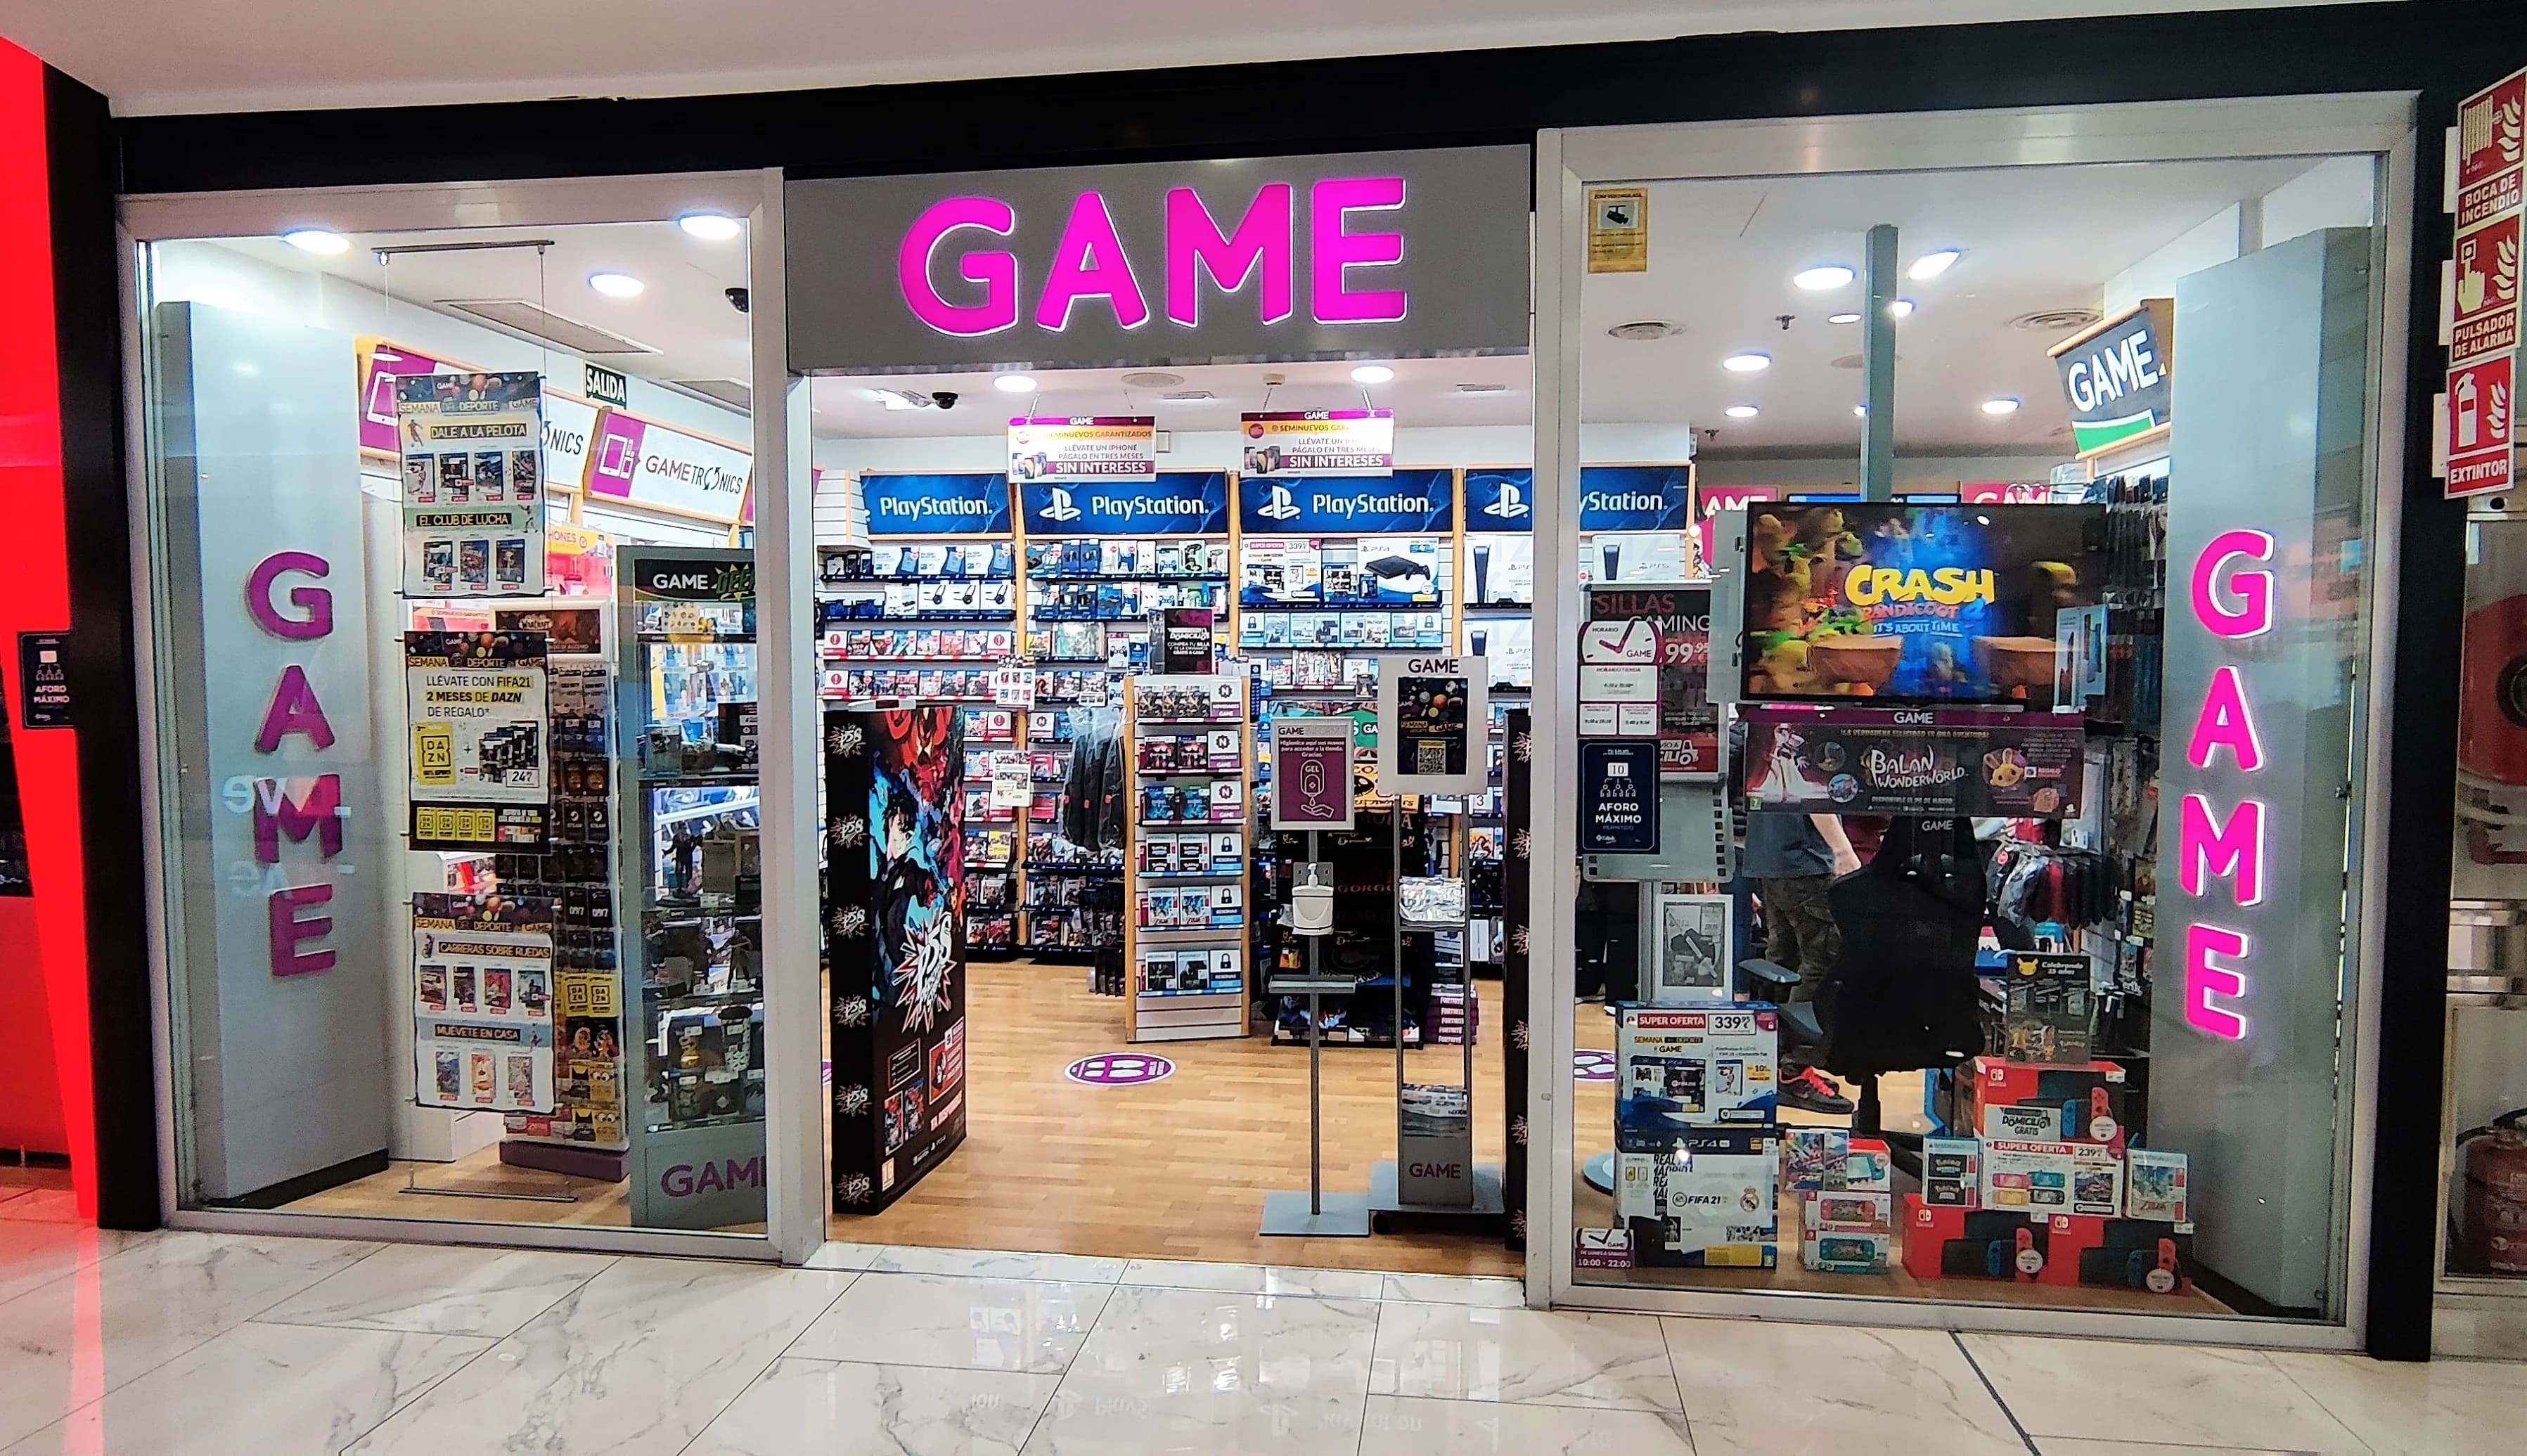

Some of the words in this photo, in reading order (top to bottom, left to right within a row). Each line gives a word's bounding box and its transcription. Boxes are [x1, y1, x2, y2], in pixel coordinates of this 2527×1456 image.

[2464, 182, 2497, 208] BOCA
[2500, 173, 2516, 193] DE
[2461, 188, 2519, 225] INCENDIO
[899, 176, 1407, 337] GAME
[2455, 311, 2514, 343] PULSADOR
[2454, 344, 2467, 359] DE
[2469, 330, 2514, 354] ALARMA
[2067, 329, 2159, 413] GAME
[586, 363, 626, 402] SALIDA
[399, 402, 439, 413] SEMANA
[459, 401, 500, 411] DEPORTE
[1069, 417, 1094, 425] GAME
[1304, 411, 1329, 420] GAME
[431, 427, 457, 439] DALE
[460, 426, 468, 437] A
[470, 426, 485, 437] LA
[487, 425, 527, 437] PELOTA
[1058, 451, 1088, 460] PÁGALO
[1292, 446, 1323, 454] PÁGALO
[1055, 463, 1079, 473] SIN
[1080, 461, 1147, 473] INTERESES
[1289, 456, 1311, 468] SIN
[1313, 455, 1384, 467] INTERESES
[2450, 458, 2508, 485] EXTINTOR
[419, 516, 431, 526] EL
[433, 515, 460, 525] CLUB
[461, 515, 475, 525] DE
[475, 514, 509, 524] LUCHA
[652, 573, 709, 590] GAME
[1844, 564, 1995, 606] CRASH
[1596, 594, 1676, 614] SILLAS
[1873, 622, 1893, 633] IT'S
[1894, 622, 1930, 634] ABOUT
[1626, 650, 1652, 658] GAME
[408, 657, 449, 667] SEMANA
[467, 658, 506, 667] DEPORTE
[1408, 658, 1460, 674] GAME
[426, 675, 469, 687] LLÉVATE
[471, 676, 494, 688] CON
[496, 676, 532, 688] FIFA21
[34, 684, 67, 693] AFORO
[33, 694, 70, 704] MÁXIMO
[426, 692, 434, 702] 2
[436, 691, 472, 702] MESES
[475, 692, 488, 702] DE
[491, 692, 522, 703] DAZN
[427, 707, 442, 717] DE
[1893, 711, 1934, 725] GAME
[1278, 727, 1305, 735] GAME
[427, 740, 444, 750] DA
[244, 550, 343, 977] GAME
[427, 753, 445, 762] ZN
[1304, 765, 1320, 773] GEL
[1612, 764, 1625, 775] 10
[1870, 745, 1935, 785] BALAN
[1877, 766, 1966, 789] WONDERWORLD
[2180, 529, 2275, 1040] GAME
[1597, 802, 1639, 812] AFORO
[1595, 813, 1642, 824] MÁXIMO
[1921, 820, 1954, 832] GAME
[416, 918, 455, 929] SEMANA
[473, 921, 513, 932] DEPORTE
[439, 943, 484, 955] CARRERAS
[485, 945, 515, 956] SOBRE
[515, 946, 551, 958] RUEDAS
[1639, 1015, 1671, 1026] SUPER
[1671, 1014, 1705, 1026] OFERTA
[480, 1028, 493, 1038] EN
[494, 1029, 520, 1040] CASA
[2014, 1127, 2039, 1135] GRATIS
[1687, 1139, 1718, 1148] PS4
[1996, 1141, 2027, 1152] SUPER
[2029, 1144, 2068, 1154] OFERTA
[1408, 1162, 1462, 1180] GAME
[1710, 1196, 1721, 1204] 21
[1577, 1258, 1601, 1267] 10:00
[1607, 1259, 1631, 1268] 22:00
